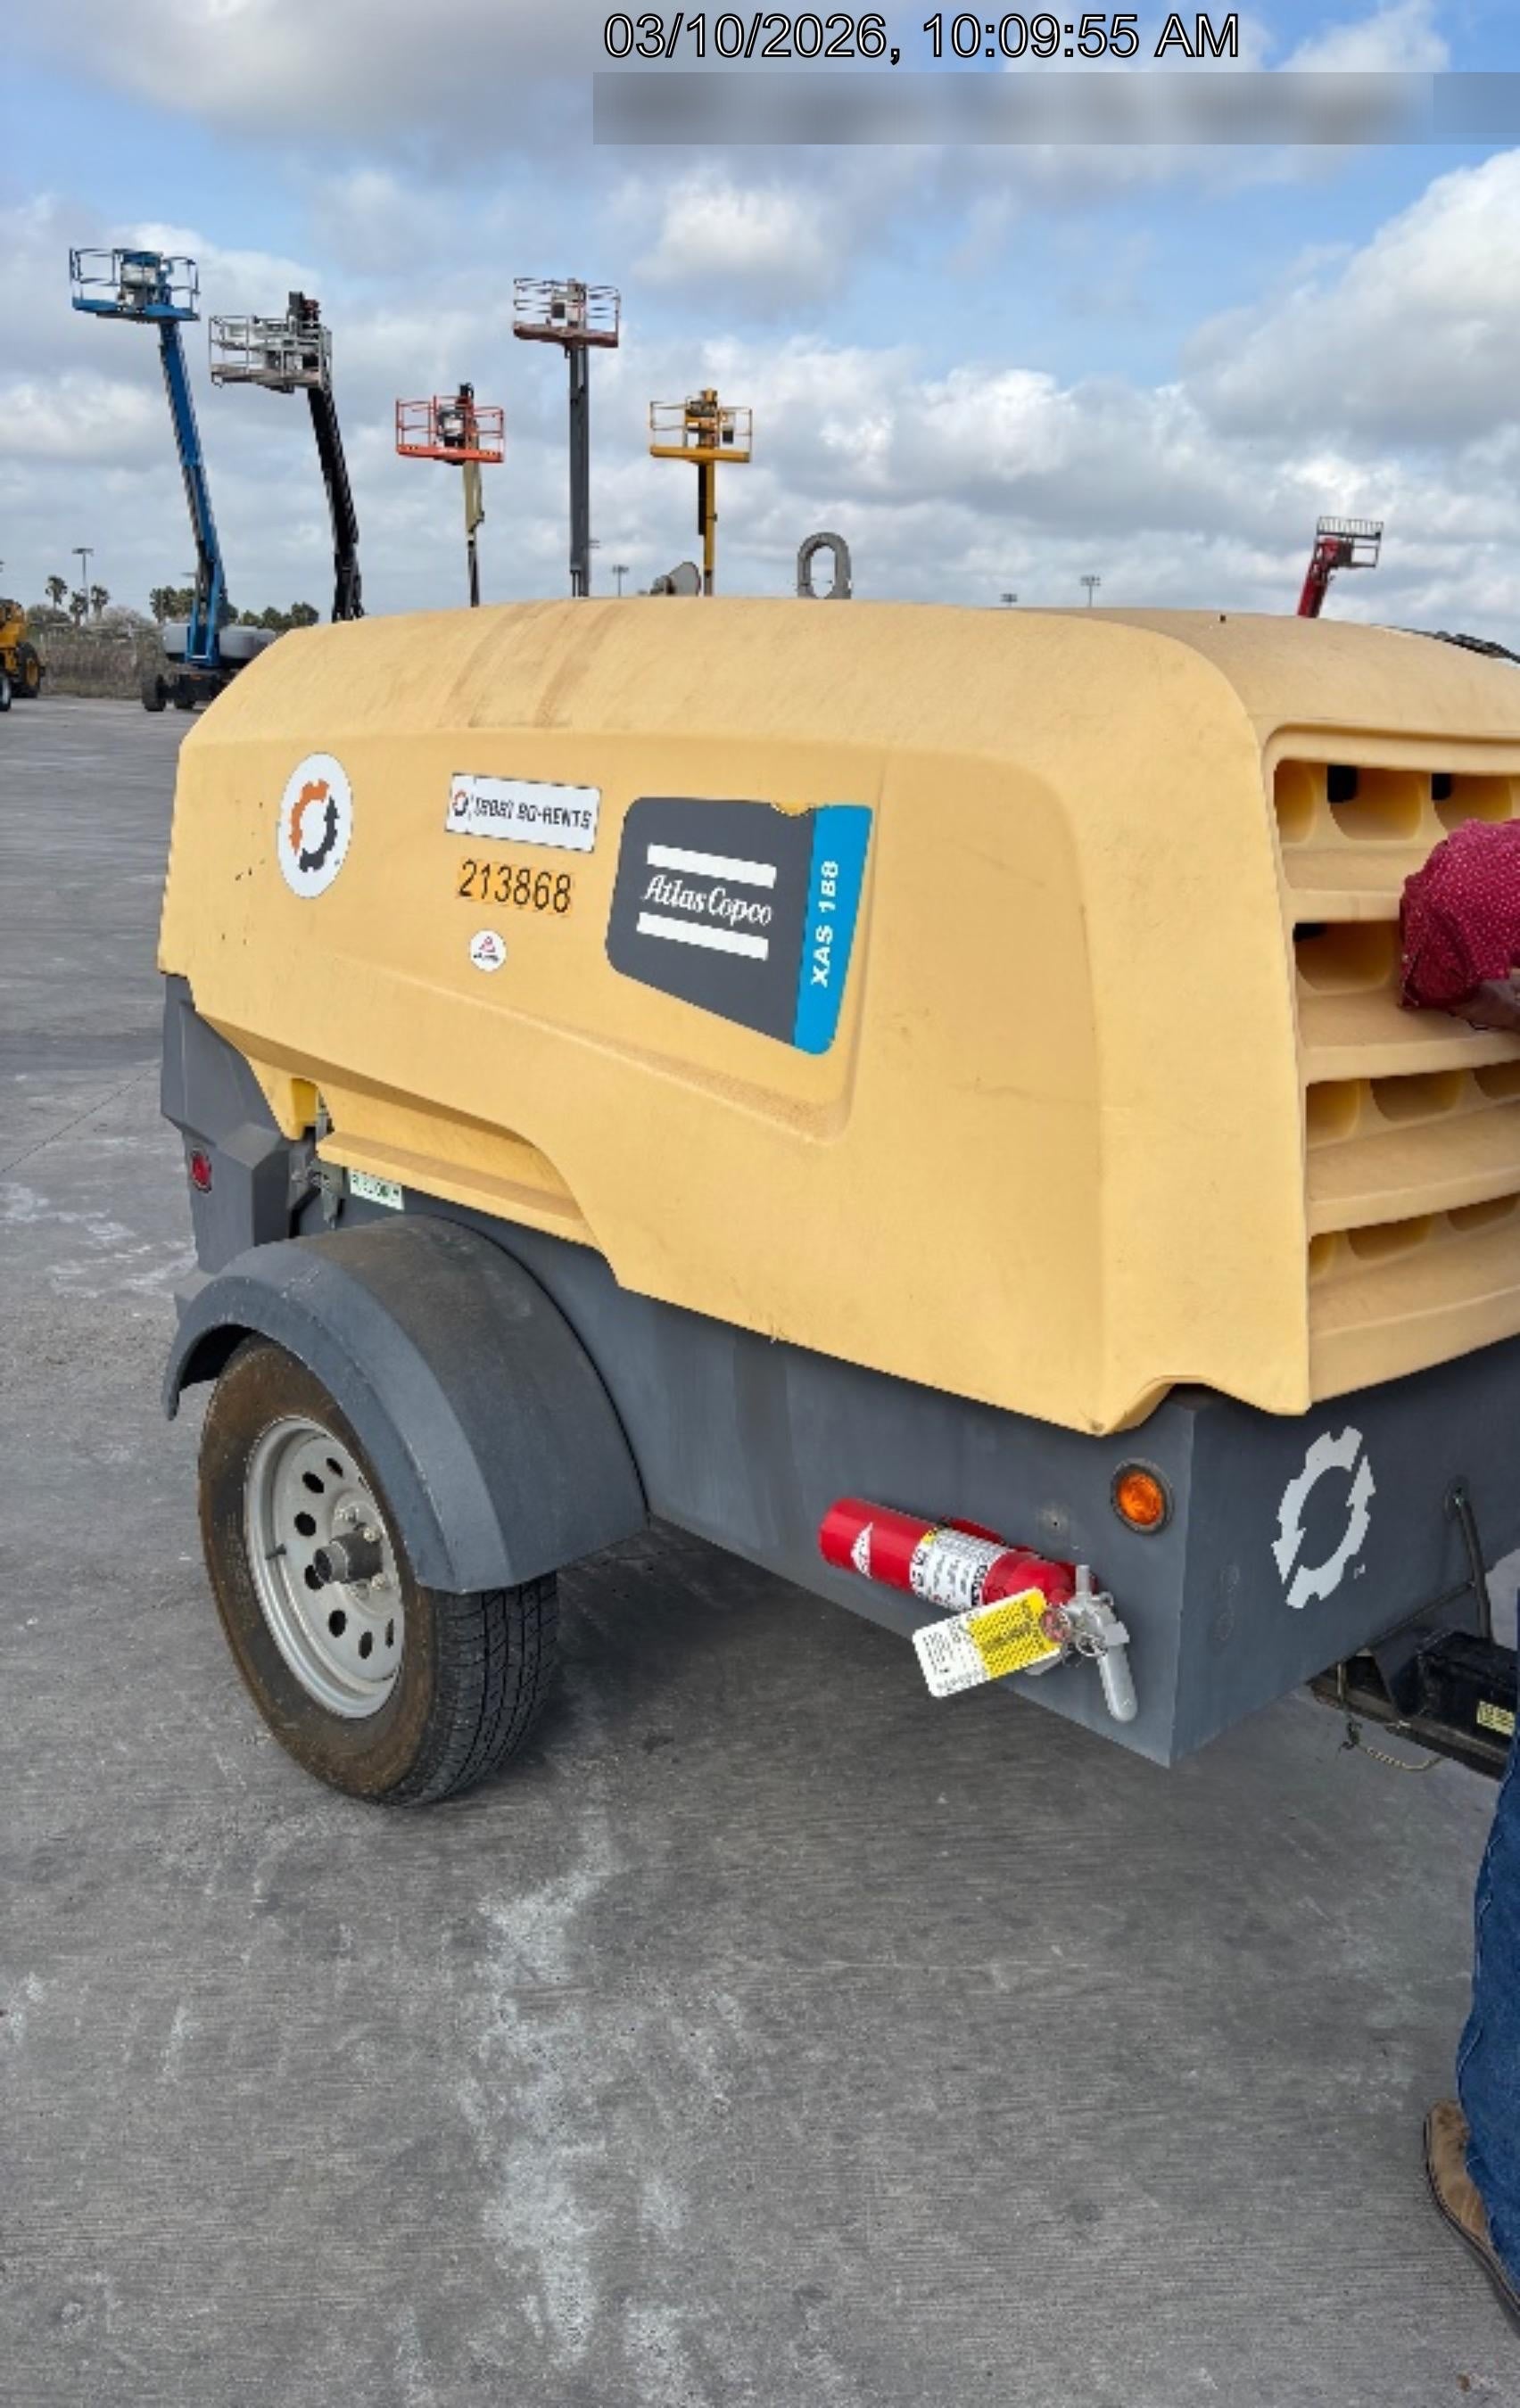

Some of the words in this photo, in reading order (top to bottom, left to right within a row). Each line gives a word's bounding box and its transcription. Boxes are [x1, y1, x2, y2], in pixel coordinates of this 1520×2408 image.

[458, 859, 572, 914] 213868
[640, 873, 707, 913] Atlas
[708, 886, 773, 926] Copco
[818, 861, 839, 912] 188
[810, 924, 834, 988] XAS
